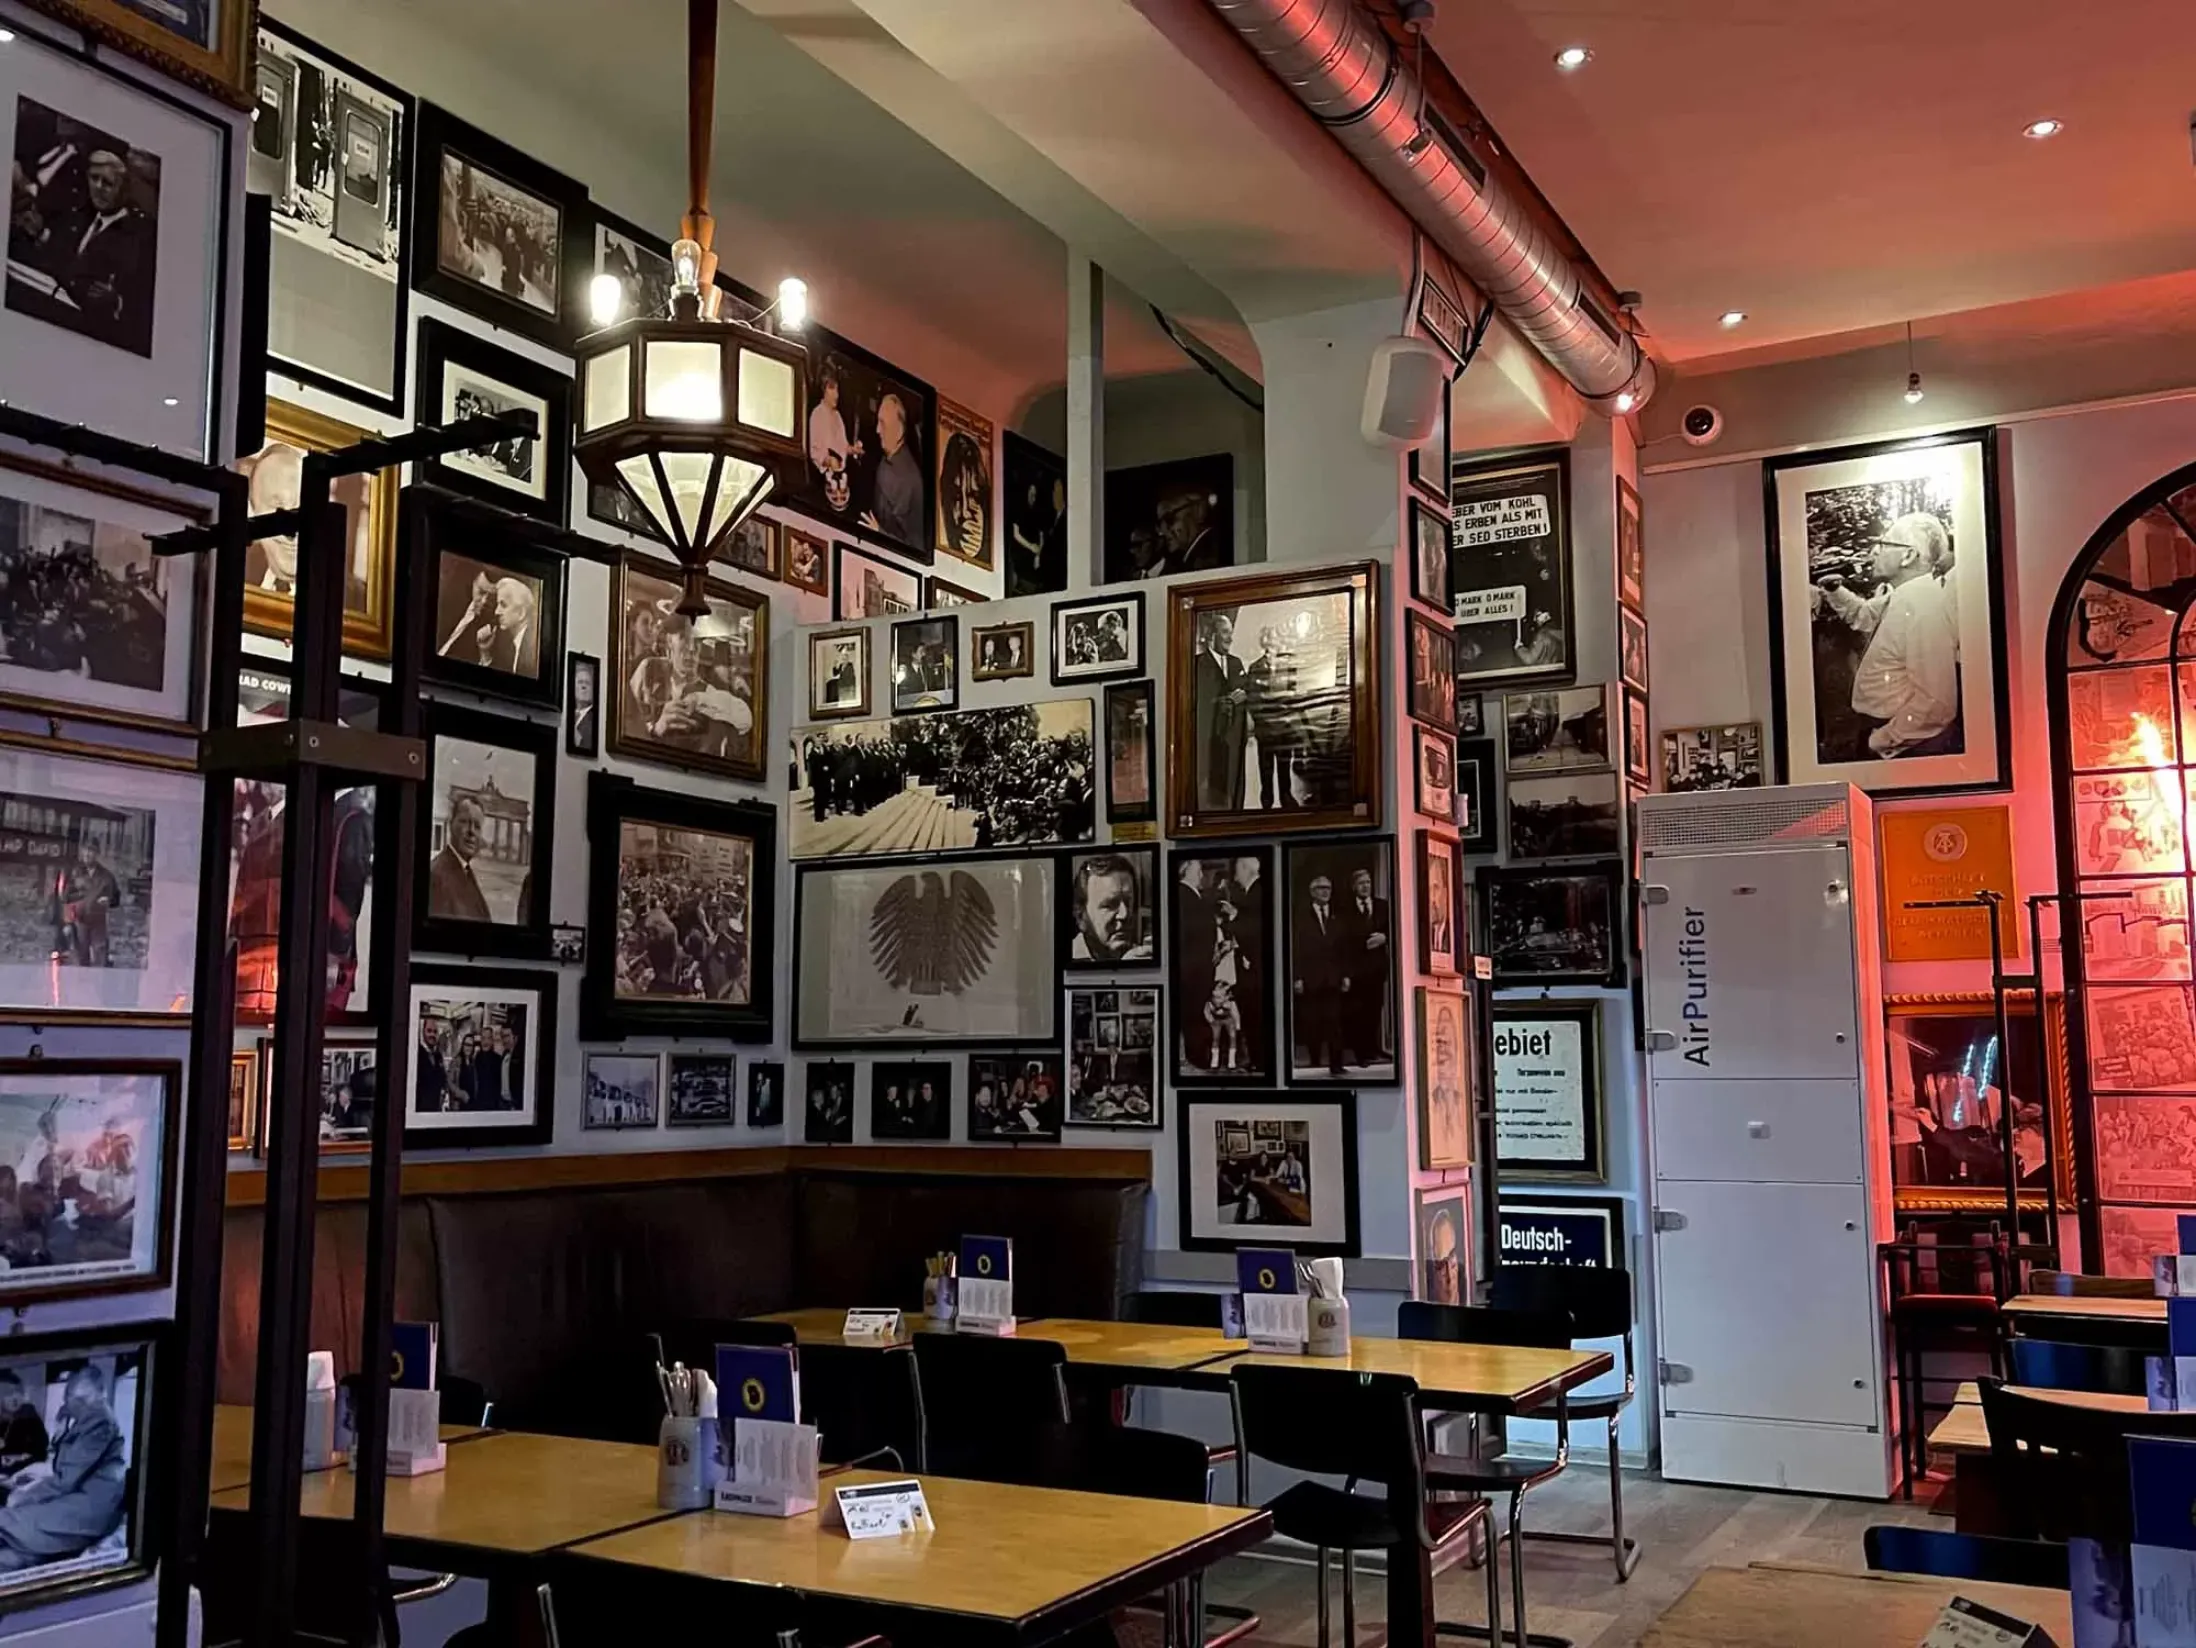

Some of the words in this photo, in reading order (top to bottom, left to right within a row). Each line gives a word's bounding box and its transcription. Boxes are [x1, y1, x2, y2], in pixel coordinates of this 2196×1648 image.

[1480, 501, 1501, 513] VOM
[1508, 497, 1536, 509] KOHL
[1465, 515, 1497, 529] ERBEN
[1502, 511, 1522, 523] ALS
[1525, 508, 1543, 520] MIT
[1469, 531, 1490, 543] SED
[1679, 906, 1710, 1067] AirPurifier
[1494, 1028, 1552, 1056] ebiet
[1501, 1224, 1572, 1252] Deutsch-
